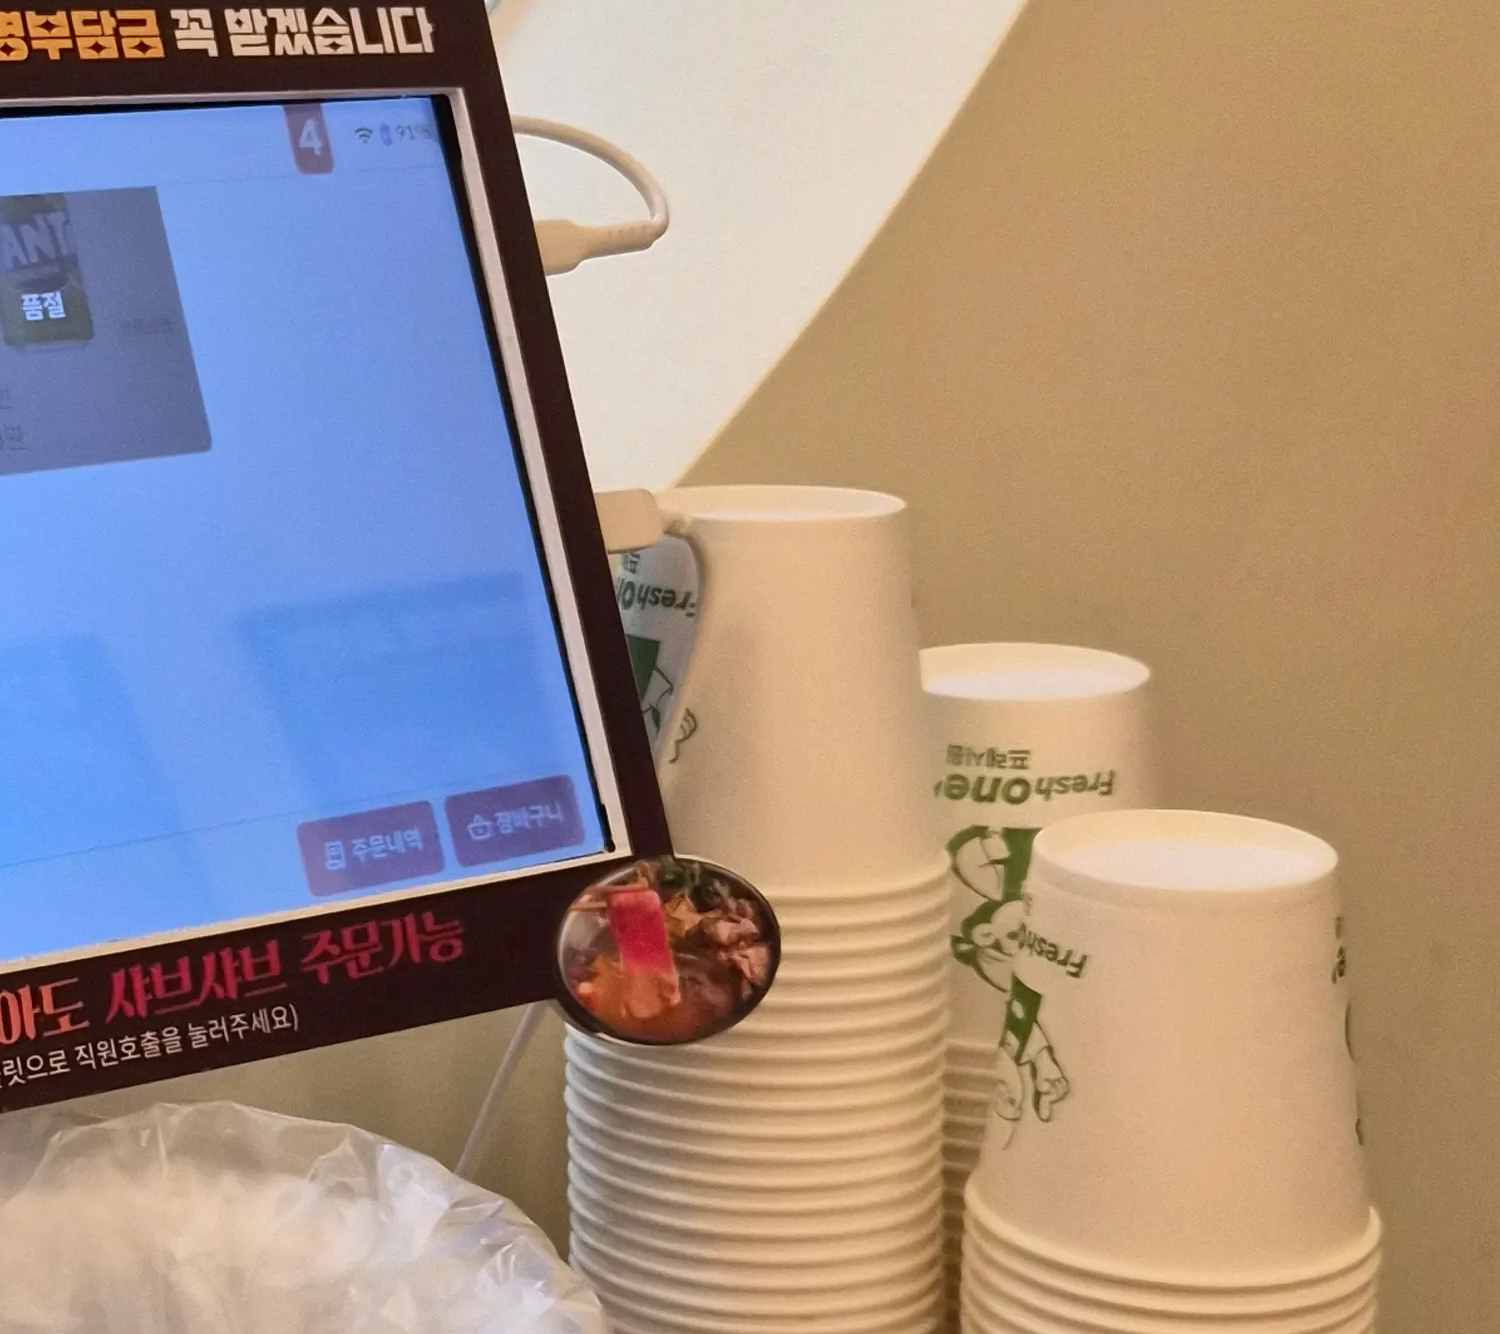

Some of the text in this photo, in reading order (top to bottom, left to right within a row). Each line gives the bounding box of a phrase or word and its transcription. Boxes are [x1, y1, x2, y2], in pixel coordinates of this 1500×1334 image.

[170, 8, 219, 58] 꼭
[224, 6, 435, 57] 받겠습니다
[300, 119, 321, 156] 4
[21, 291, 66, 321] 품절
[350, 825, 425, 863] 주문내역
[105, 938, 289, 1024] 샤브샤브
[301, 910, 466, 985] 주문가능
[74, 1026, 184, 1069] 직원호출을
[187, 1002, 299, 1053] 눌러주세요)
